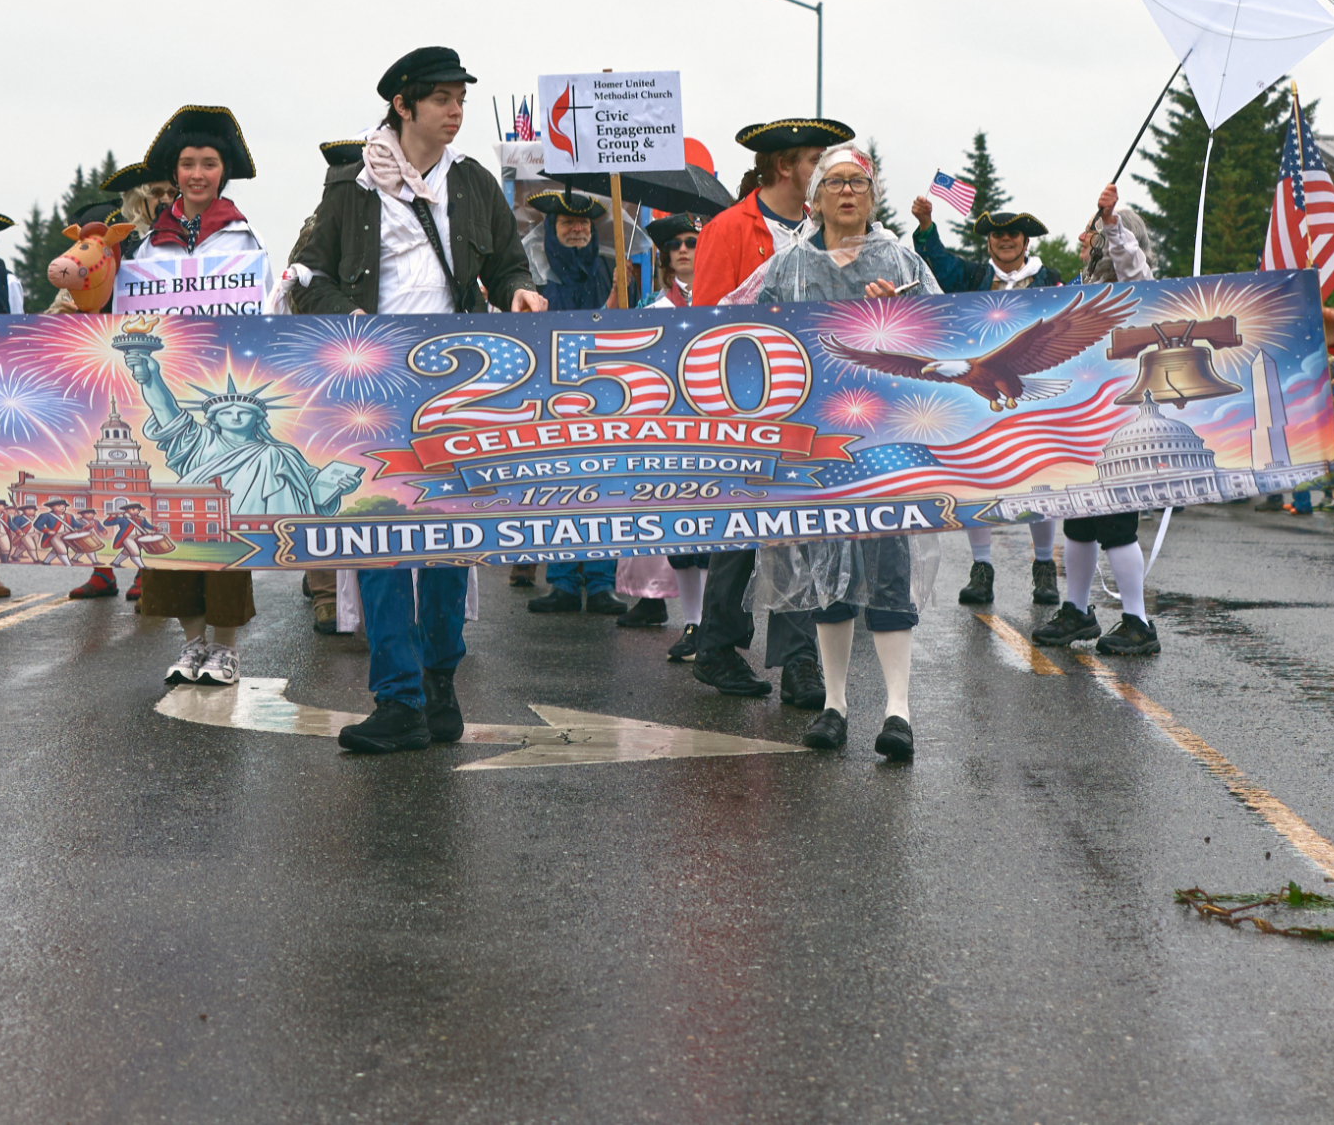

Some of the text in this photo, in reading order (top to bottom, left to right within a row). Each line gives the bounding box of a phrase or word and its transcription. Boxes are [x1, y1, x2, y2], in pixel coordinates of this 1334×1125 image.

[594, 79, 655, 88] Homer United
[594, 90, 673, 101] Methodist Church
[595, 110, 629, 122] Civic
[596, 123, 676, 138] Engagement
[597, 137, 654, 152] Group &
[597, 151, 646, 164] Friends
[125, 272, 256, 297] THE BRITISH
[406, 322, 813, 433] 250
[443, 421, 782, 456] CELEBRATING
[476, 456, 763, 483] YEARS OF FREEDOM
[518, 483, 600, 507] 1776
[630, 480, 723, 502] 2026
[305, 505, 934, 557] UNITED STATES OF AMERICA
[500, 552, 576, 565] LAND
[632, 542, 750, 556] LIBERTY
